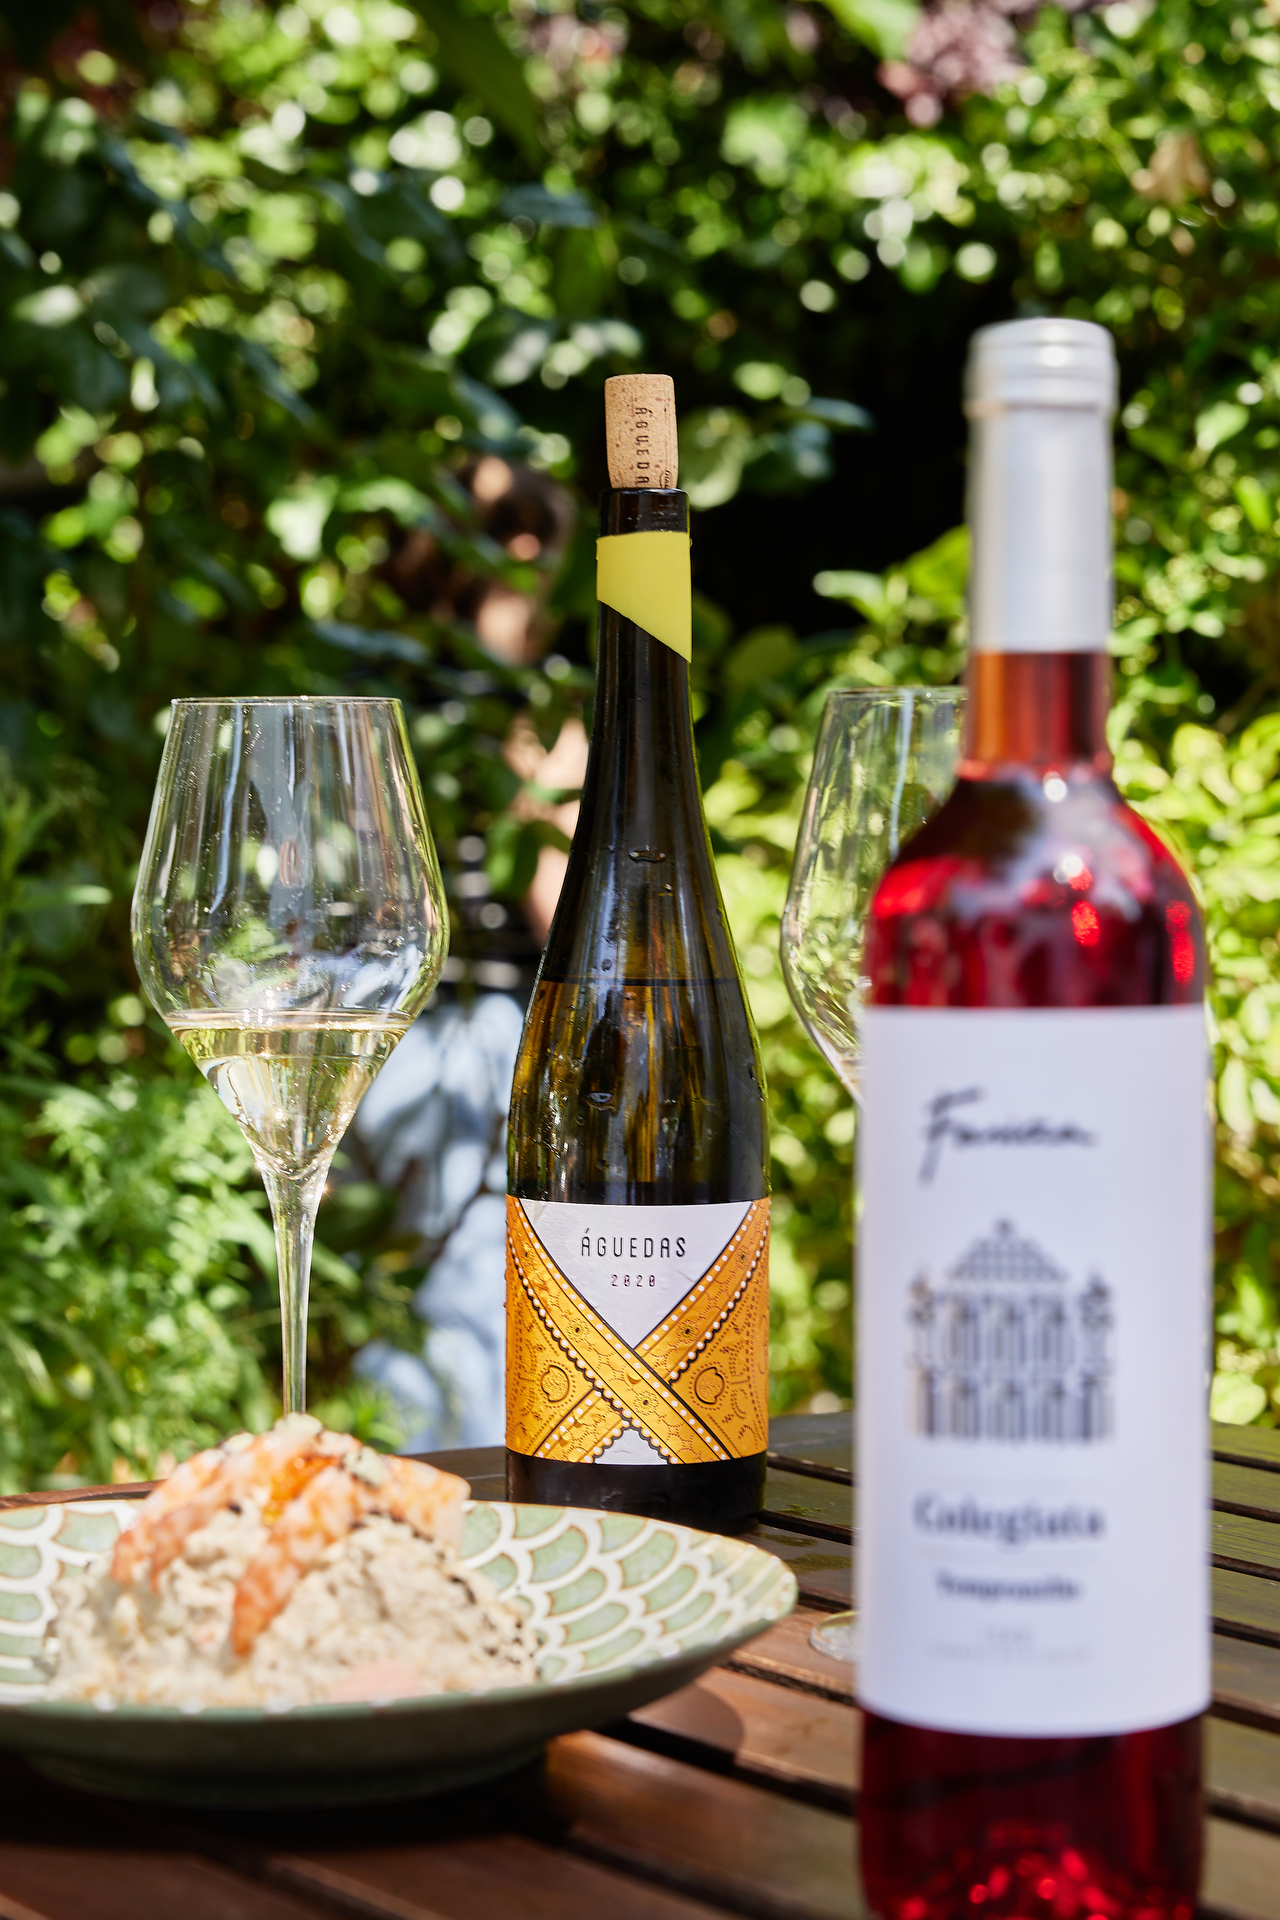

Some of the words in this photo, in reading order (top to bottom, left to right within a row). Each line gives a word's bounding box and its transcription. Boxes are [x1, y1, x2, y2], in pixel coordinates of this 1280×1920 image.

[635, 407, 652, 484] ÁGUEDA
[581, 1227, 686, 1258] ÁGUEDAS
[611, 1274, 656, 1288] 2020
